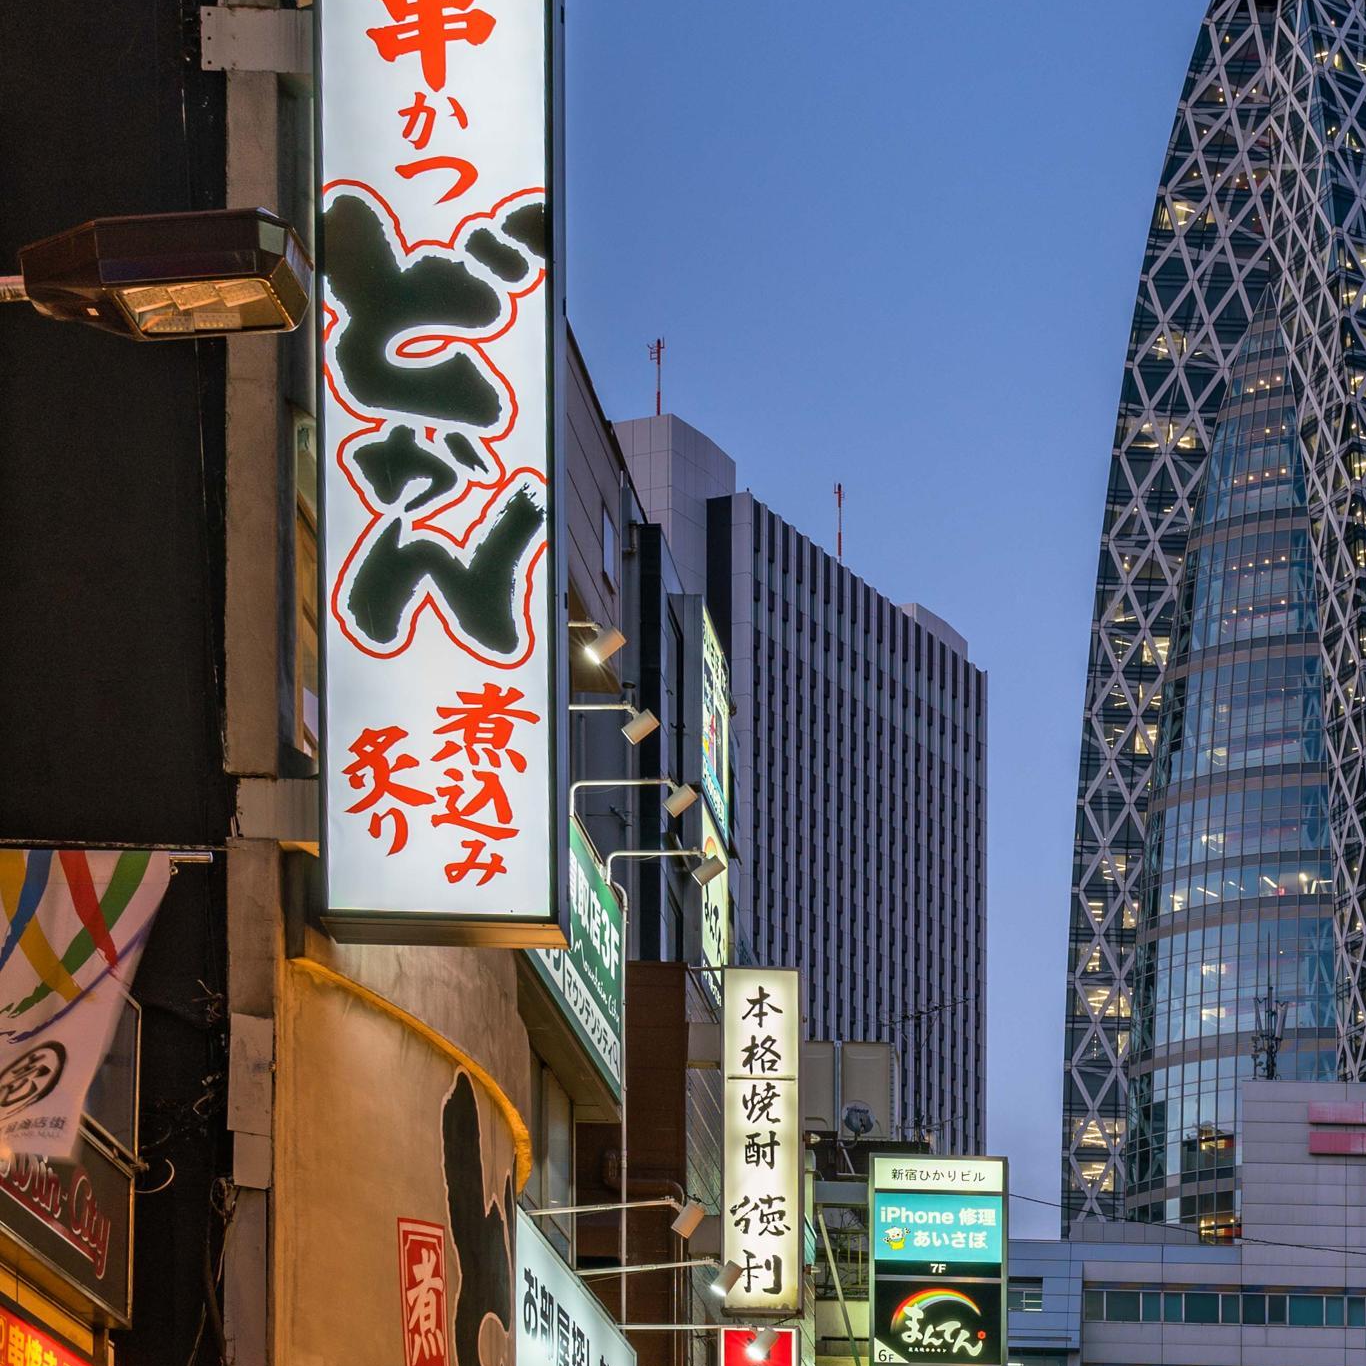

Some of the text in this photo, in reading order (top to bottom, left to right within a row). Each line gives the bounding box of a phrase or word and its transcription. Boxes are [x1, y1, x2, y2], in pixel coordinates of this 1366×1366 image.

[342, 726, 436, 857] 炙り
[430, 682, 539, 886] 煮込み
[741, 986, 783, 1170] 本格焼酎
[891, 1167, 986, 1183] 新宿ひかりビル
[880, 1206, 997, 1227] iPhone 修理
[930, 1263, 947, 1273] 7F
[901, 1303, 983, 1357] まんてん
[878, 1349, 894, 1363] 6F
